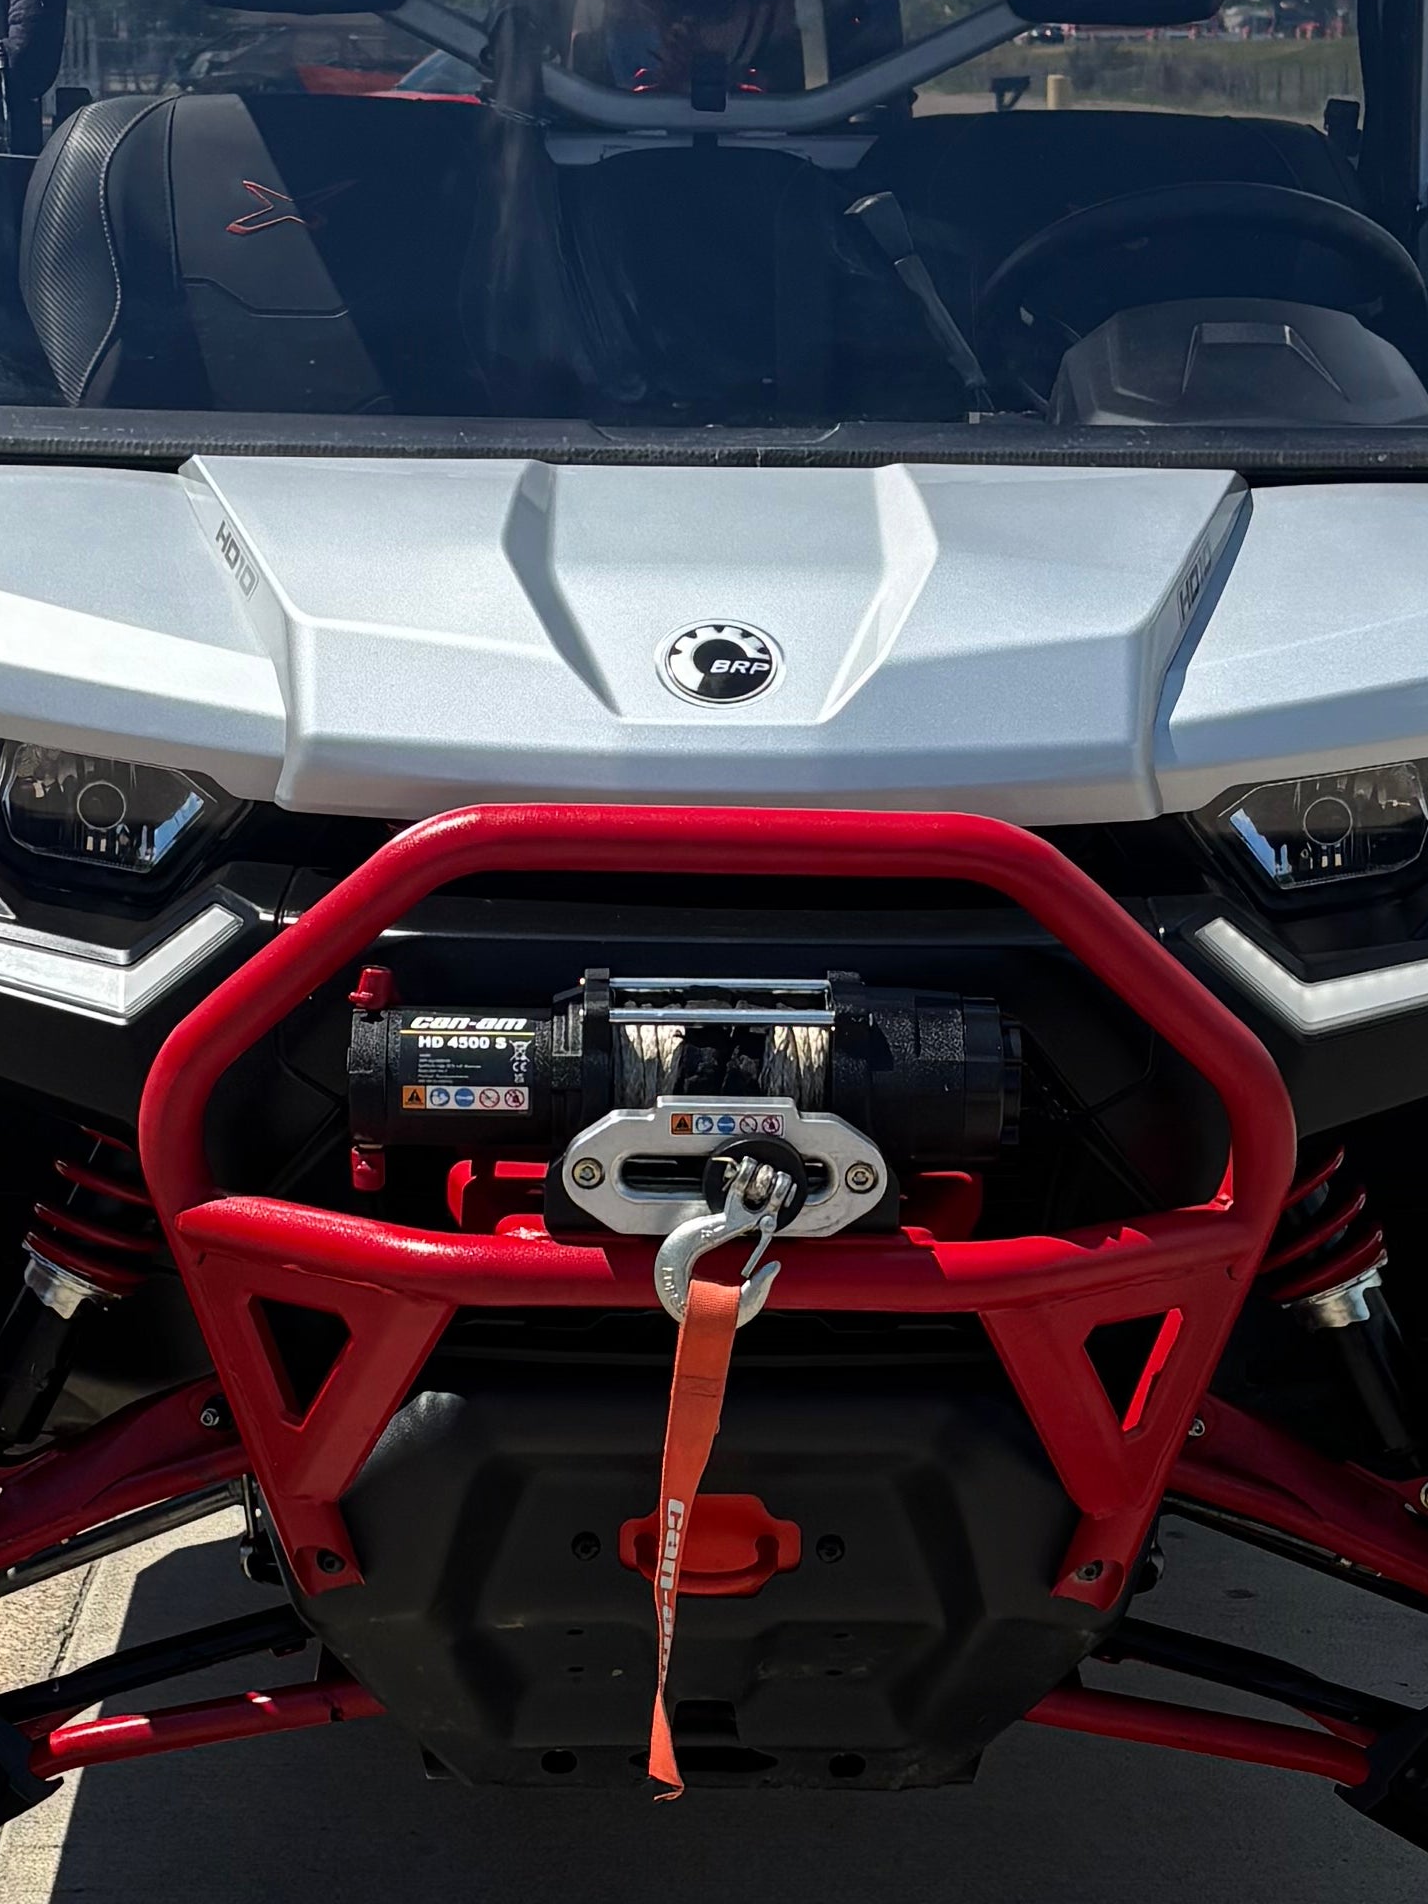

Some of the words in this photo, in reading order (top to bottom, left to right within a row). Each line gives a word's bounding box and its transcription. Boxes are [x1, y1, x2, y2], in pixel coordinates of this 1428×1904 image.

[709, 659, 770, 675] BRP
[418, 1035, 444, 1049] HD
[447, 1036, 490, 1049] 4500
[495, 1037, 508, 1050] S
